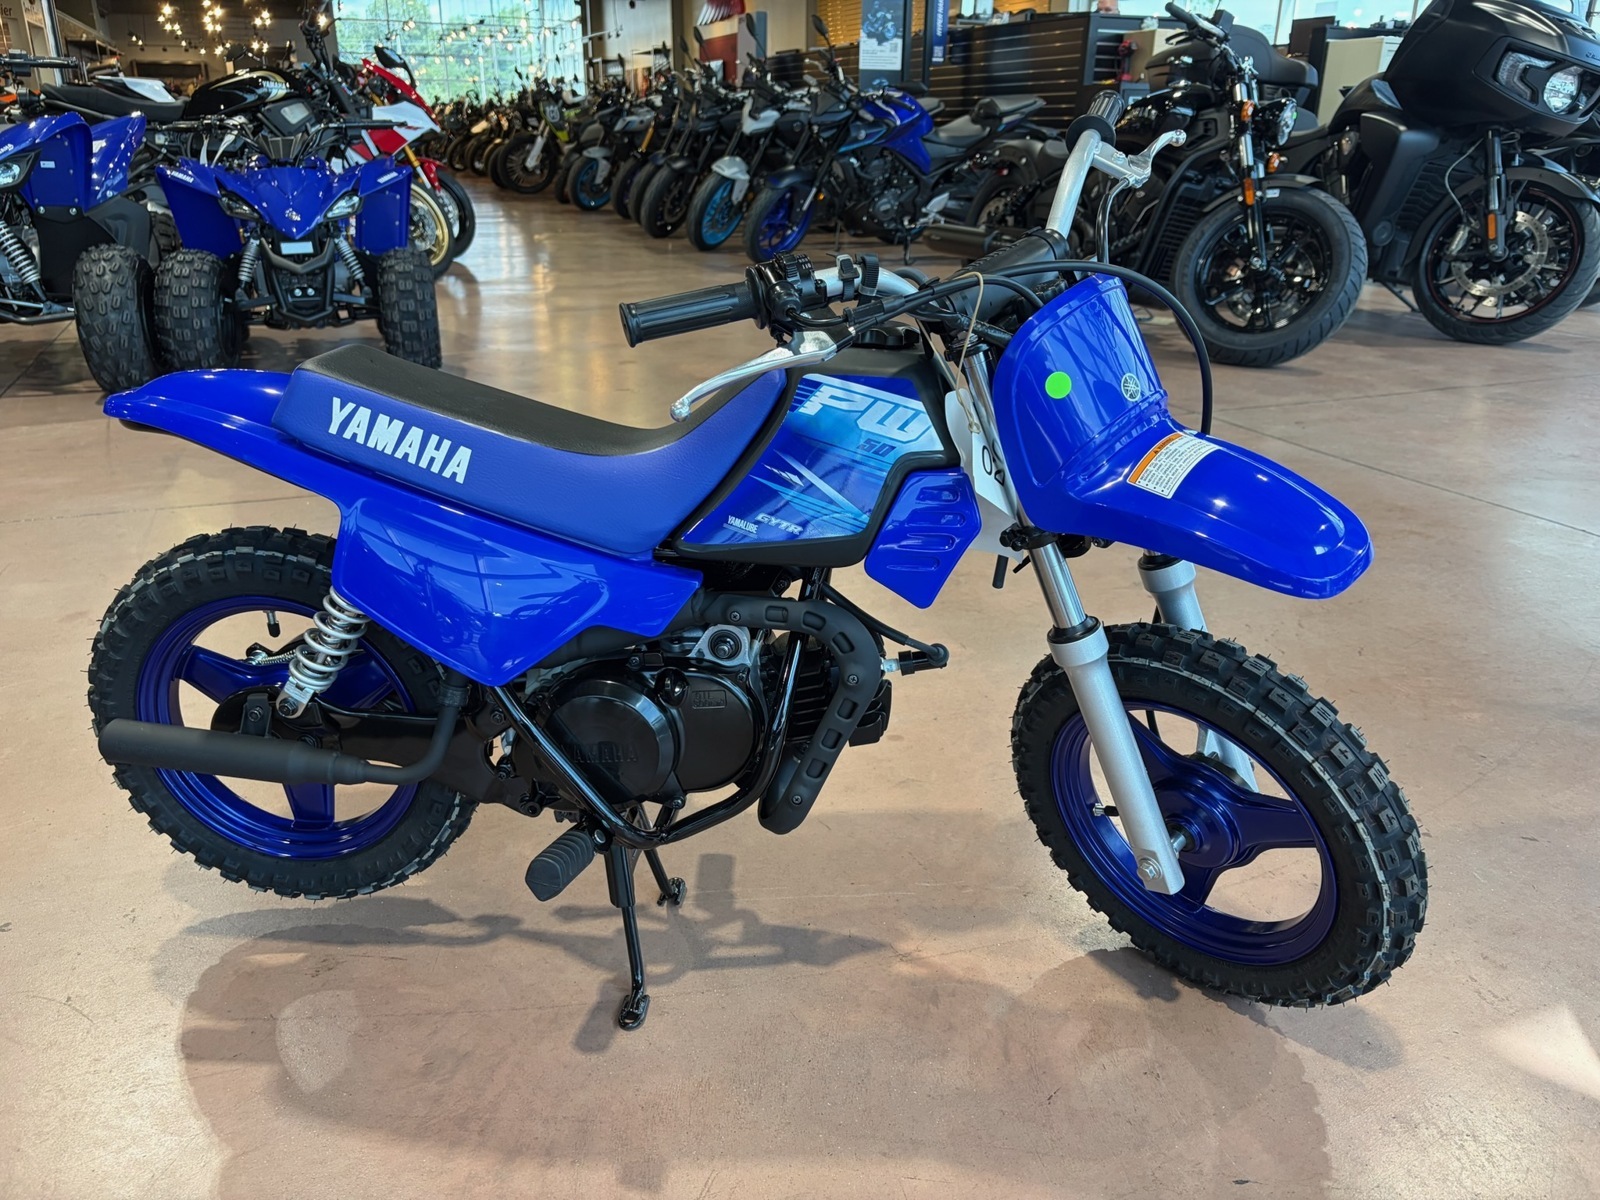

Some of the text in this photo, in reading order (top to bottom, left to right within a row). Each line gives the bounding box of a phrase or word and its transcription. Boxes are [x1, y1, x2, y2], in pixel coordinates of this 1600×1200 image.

[798, 384, 932, 442] PW
[328, 396, 472, 484] YAMAHA
[856, 438, 897, 457] 50
[727, 515, 759, 534] YAMALUBE
[755, 512, 803, 535] GYTR
